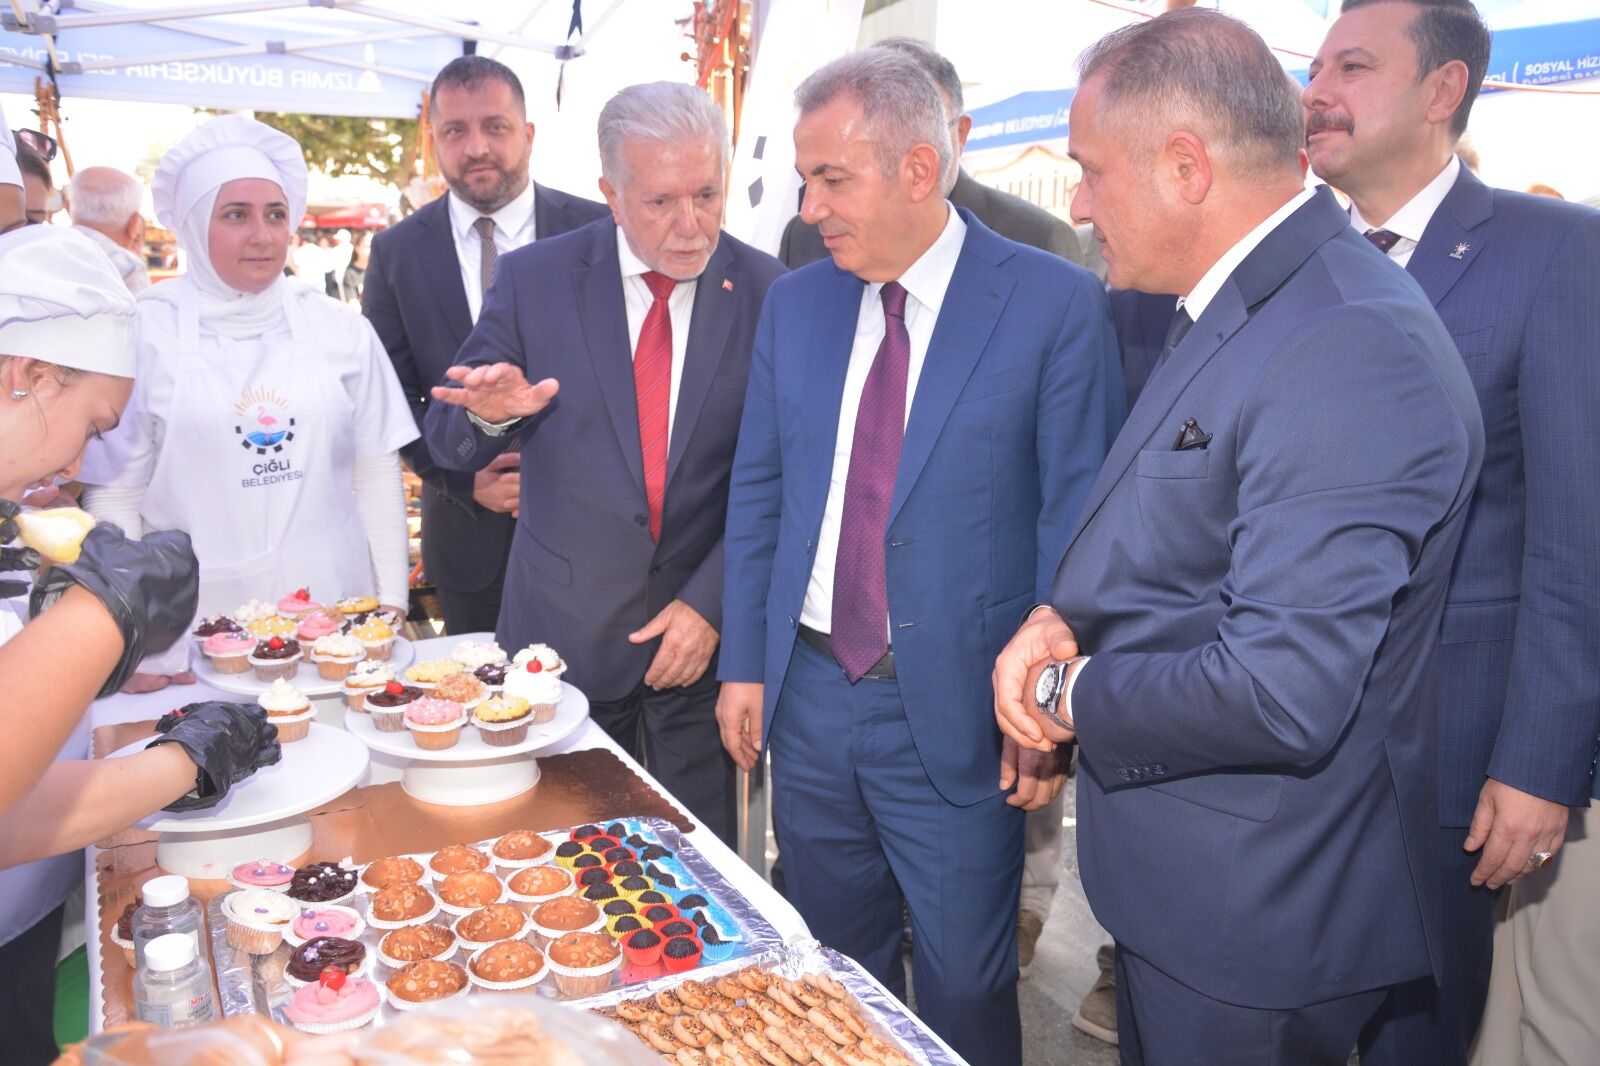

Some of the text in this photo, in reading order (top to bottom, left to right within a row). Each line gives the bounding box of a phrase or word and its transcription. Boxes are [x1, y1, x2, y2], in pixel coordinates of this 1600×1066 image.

[1525, 54, 1600, 76] SOSYAL HİZ
[252, 459, 290, 476] ÇİĞLİ
[241, 470, 303, 488] BELEDİYESİ
